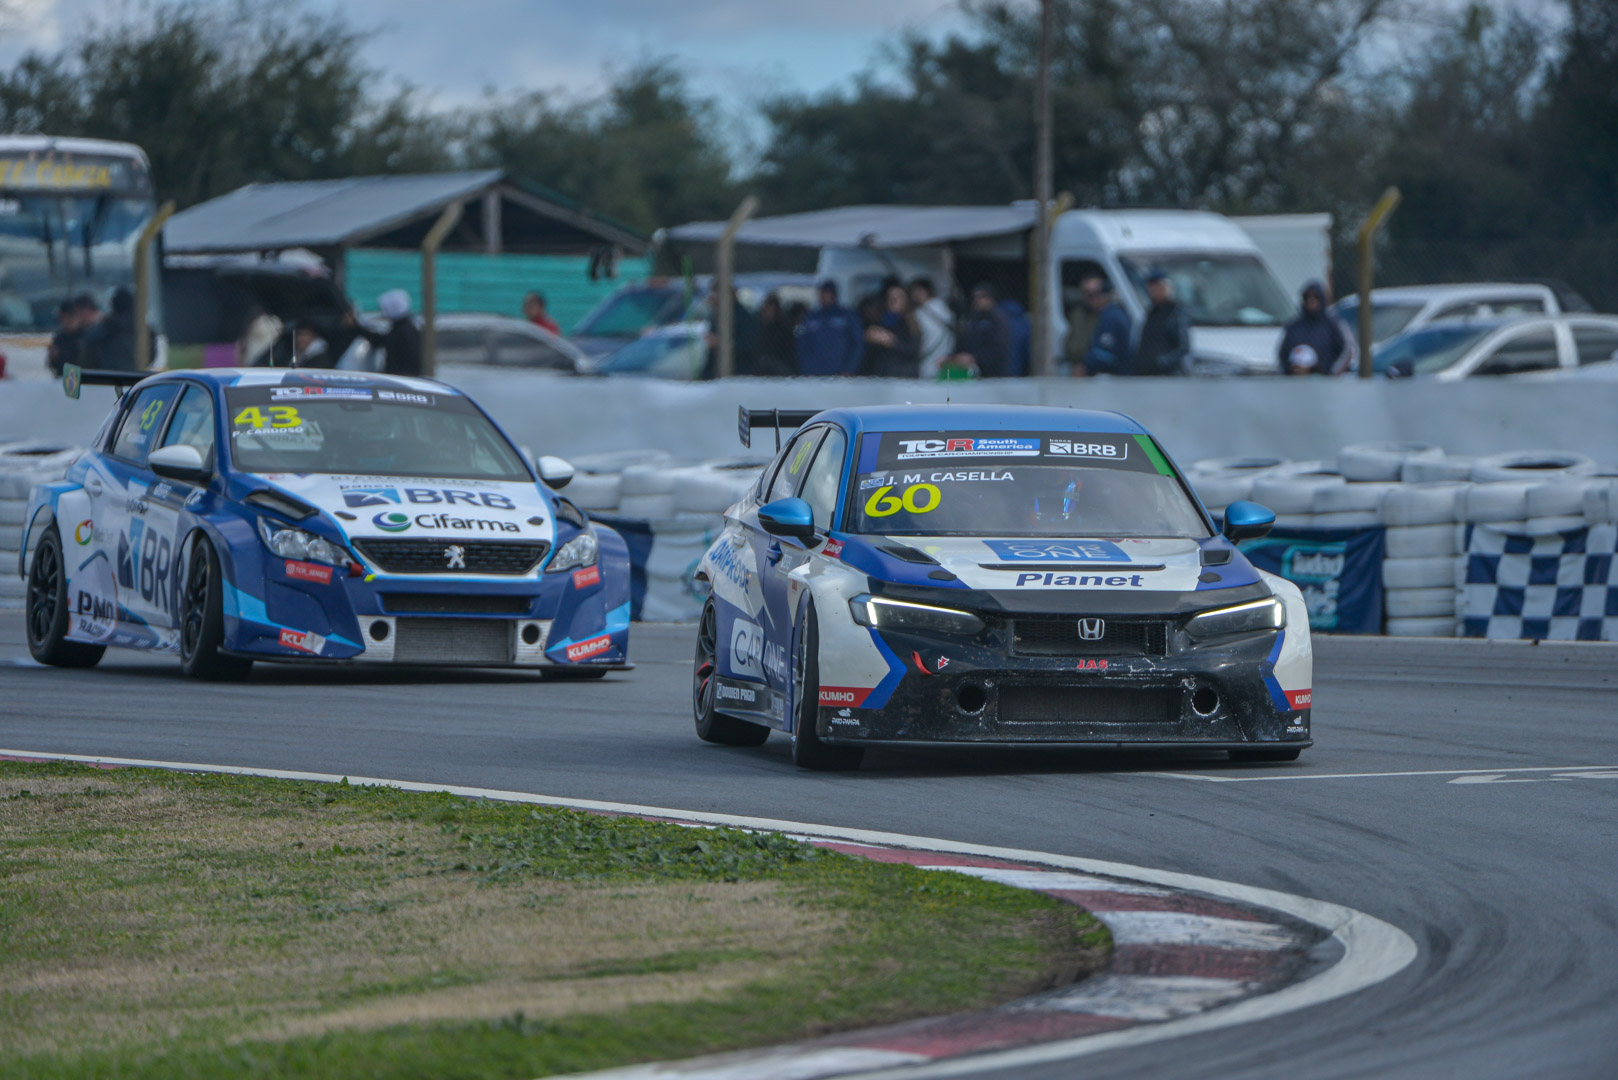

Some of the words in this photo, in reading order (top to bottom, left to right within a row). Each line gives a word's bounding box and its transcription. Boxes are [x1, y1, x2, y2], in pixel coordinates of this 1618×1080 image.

[270, 387, 323, 396] TCR
[395, 393, 428, 403] BRB
[141, 399, 163, 431] 43
[234, 406, 302, 428] 43
[247, 427, 304, 436] CARDOSO
[899, 438, 975, 453] TCR
[1073, 443, 1117, 457] BRB
[886, 477, 898, 486] J.
[903, 473, 926, 484] M.
[930, 471, 1015, 483] CASELLA
[403, 488, 516, 510] BRB
[864, 483, 942, 517] 60
[414, 513, 521, 533] Cifarma
[1013, 550, 1111, 559] ONE
[709, 540, 750, 594] OMPRODE
[1016, 572, 1144, 587] Planet
[78, 589, 114, 625] PMO
[568, 638, 610, 658] KUMHO
[734, 630, 761, 667] CAR
[764, 640, 785, 683] ONE
[1076, 659, 1109, 669] JAS
[819, 690, 855, 702] KUMHO
